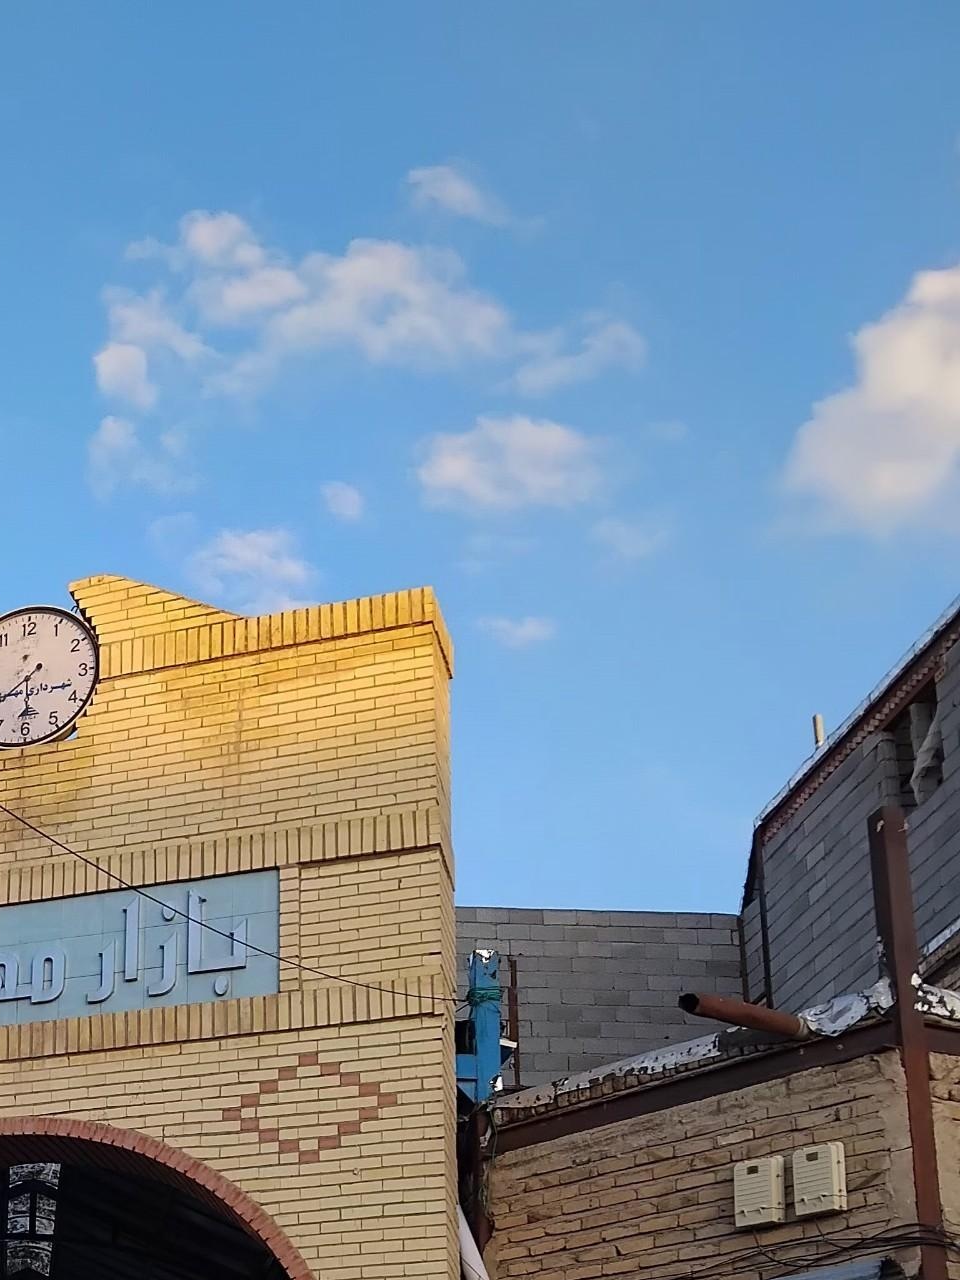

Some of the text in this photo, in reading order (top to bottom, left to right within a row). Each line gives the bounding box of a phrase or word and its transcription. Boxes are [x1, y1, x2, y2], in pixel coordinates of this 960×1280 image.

[22, 622, 37, 637] 12
[54, 623, 59, 637] 1
[70, 638, 80, 653] 2
[78, 662, 88, 677] 3
[68, 690, 78, 703] 4
[48, 711, 58, 725] 5
[20, 722, 30, 736] 6
[86, 888, 249, 1004] بازار
